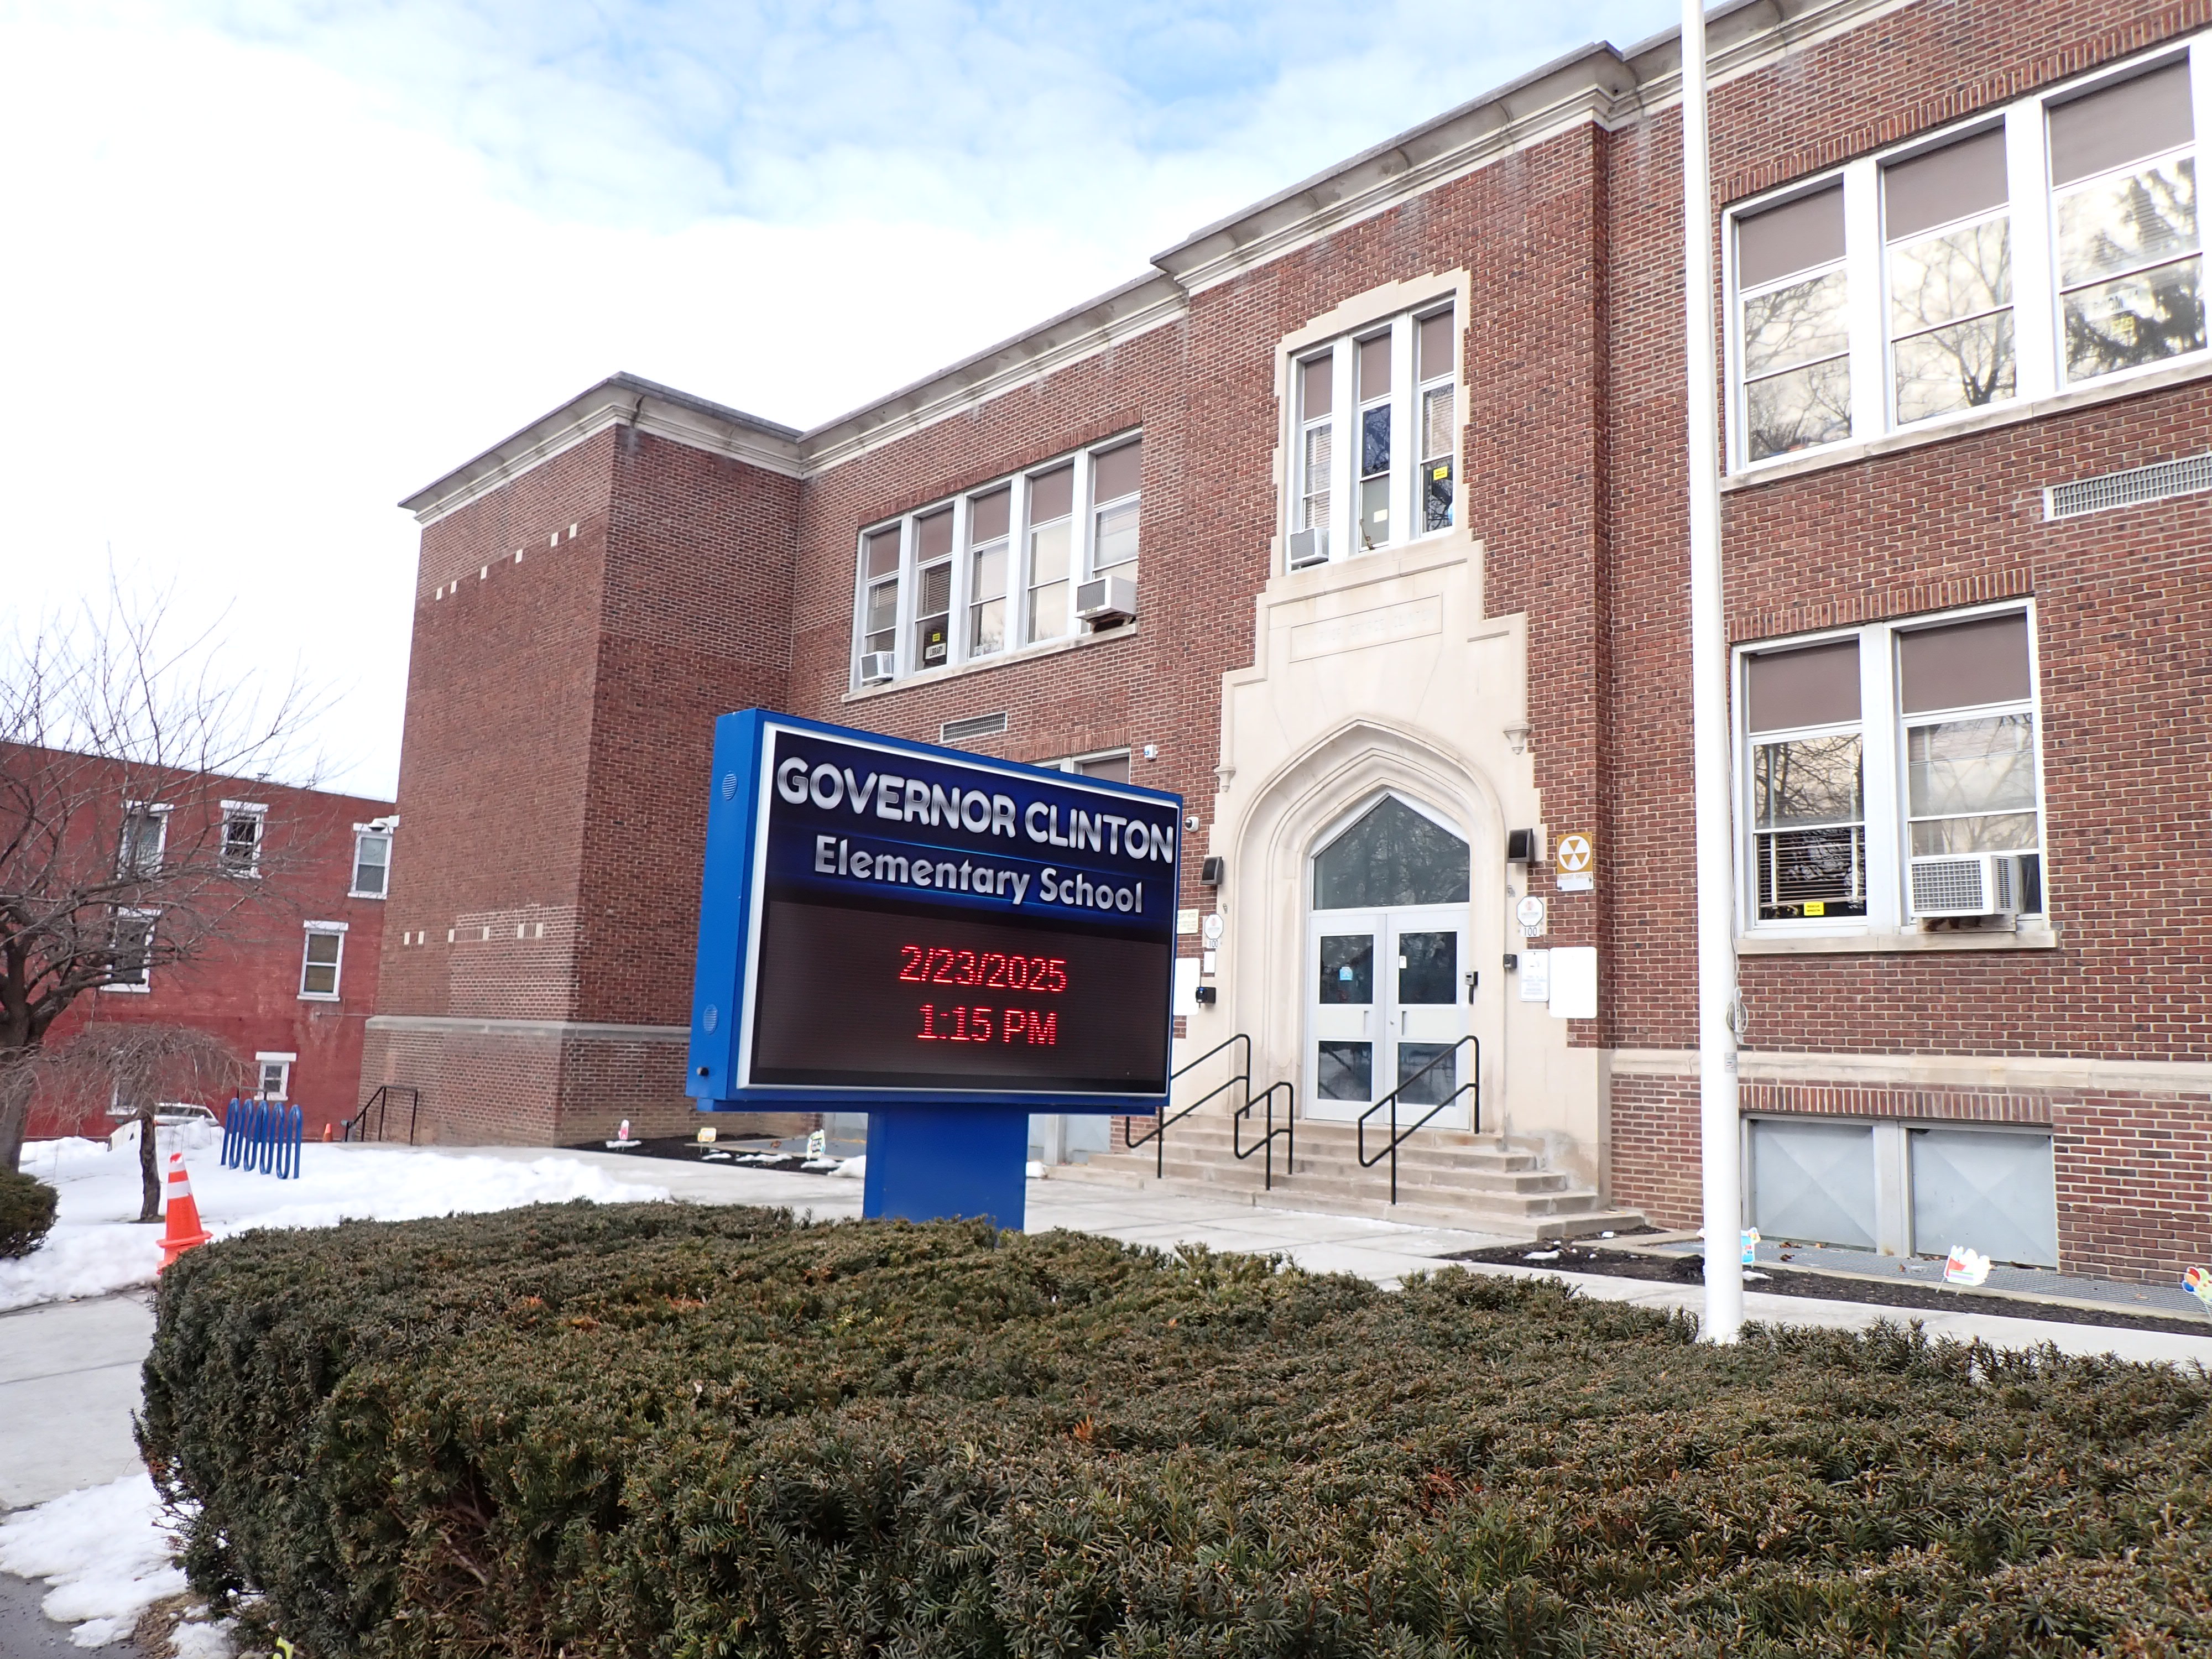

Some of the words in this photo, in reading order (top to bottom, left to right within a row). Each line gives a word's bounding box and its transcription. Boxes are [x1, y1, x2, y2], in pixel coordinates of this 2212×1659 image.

[930, 646, 943, 656] LIBRARY
[777, 757, 1016, 838] GOVERNOR
[1025, 801, 1173, 864] CLINTON
[815, 834, 1030, 905] Elementary
[1039, 867, 1142, 914] School
[1524, 927, 1537, 936] 100
[899, 945, 1068, 993] 2/23/2025
[917, 1004, 992, 1042] 1:15
[1003, 1009, 1057, 1046] PM
